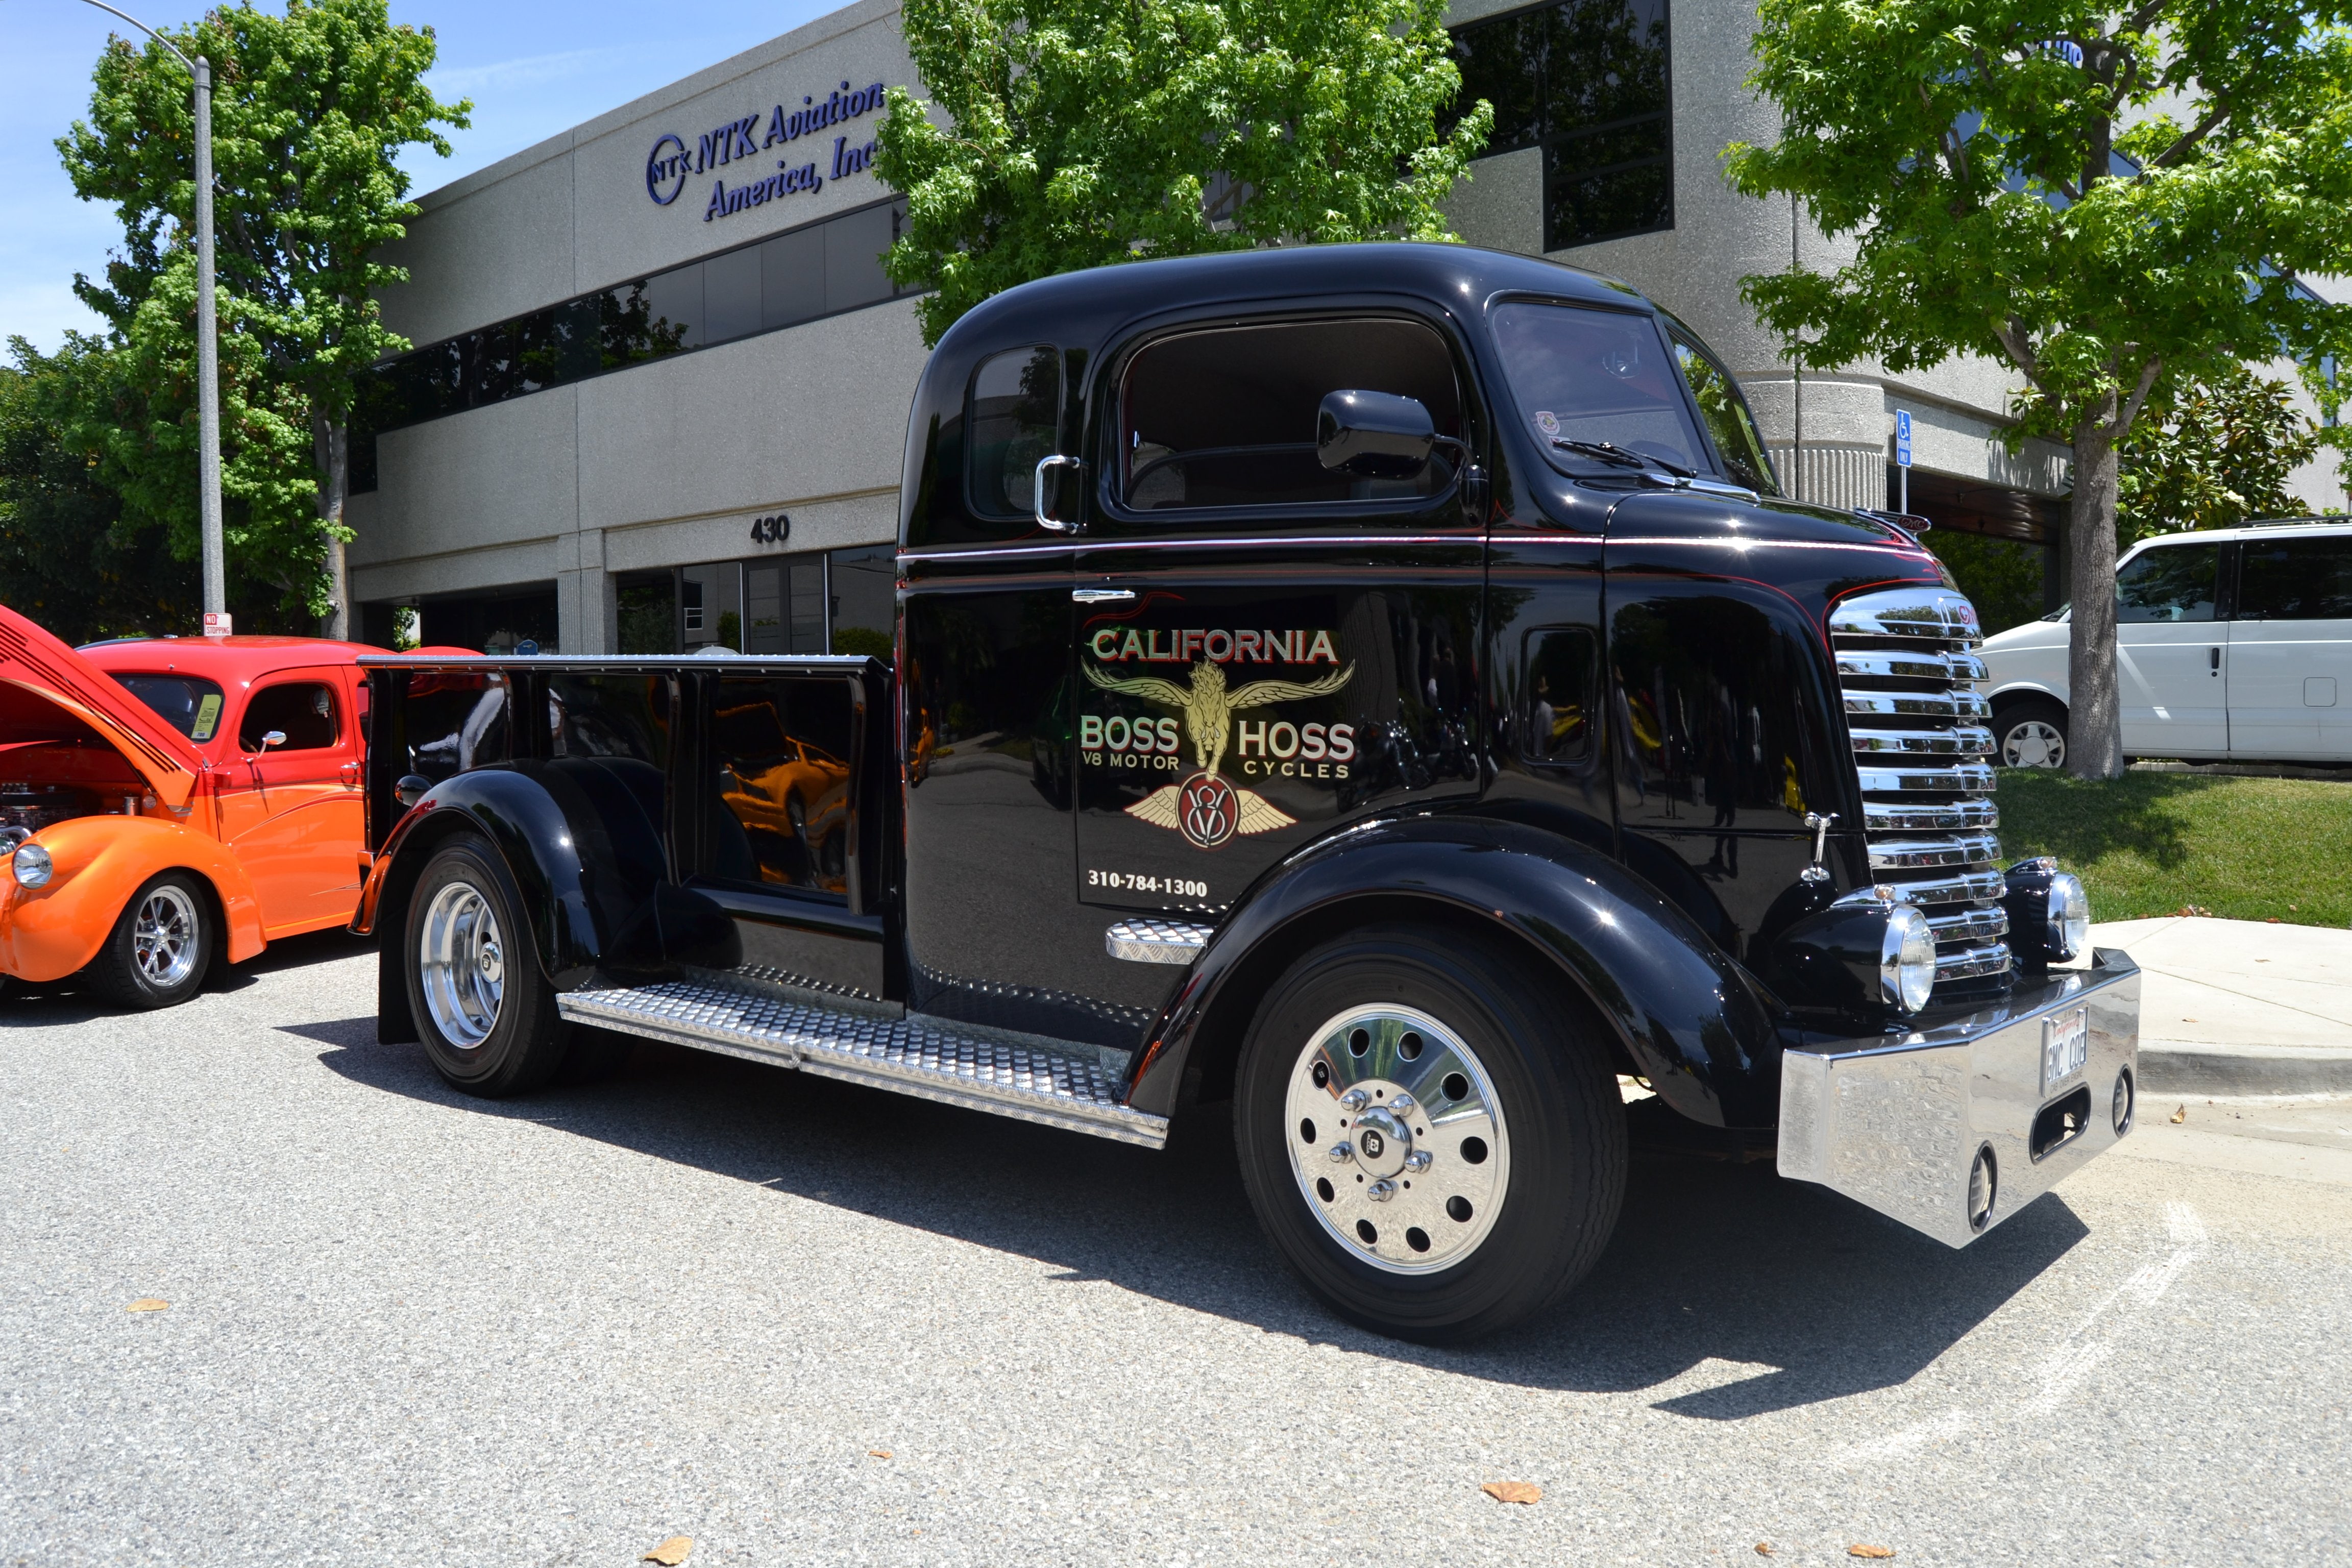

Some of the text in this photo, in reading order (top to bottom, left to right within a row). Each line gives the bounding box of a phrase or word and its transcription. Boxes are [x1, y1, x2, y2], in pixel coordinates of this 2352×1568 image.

[695, 81, 884, 174] NTK Aviation
[651, 151, 692, 183] NTK
[703, 160, 822, 222] America,
[750, 515, 790, 544] 430
[1901, 518, 1925, 529] GMC
[206, 615, 216, 624] NO
[1092, 628, 1340, 664] CALIFORNIA
[1081, 715, 1356, 762] BOSS HOSS
[1083, 751, 1349, 778] V8 MOTOR CYCLES
[1088, 870, 1208, 897] 310-784-1300
[2047, 1031, 2086, 1082] GMC COE
[2060, 1076, 2069, 1088] OVER
[2071, 1069, 2083, 1082] ENGINE
